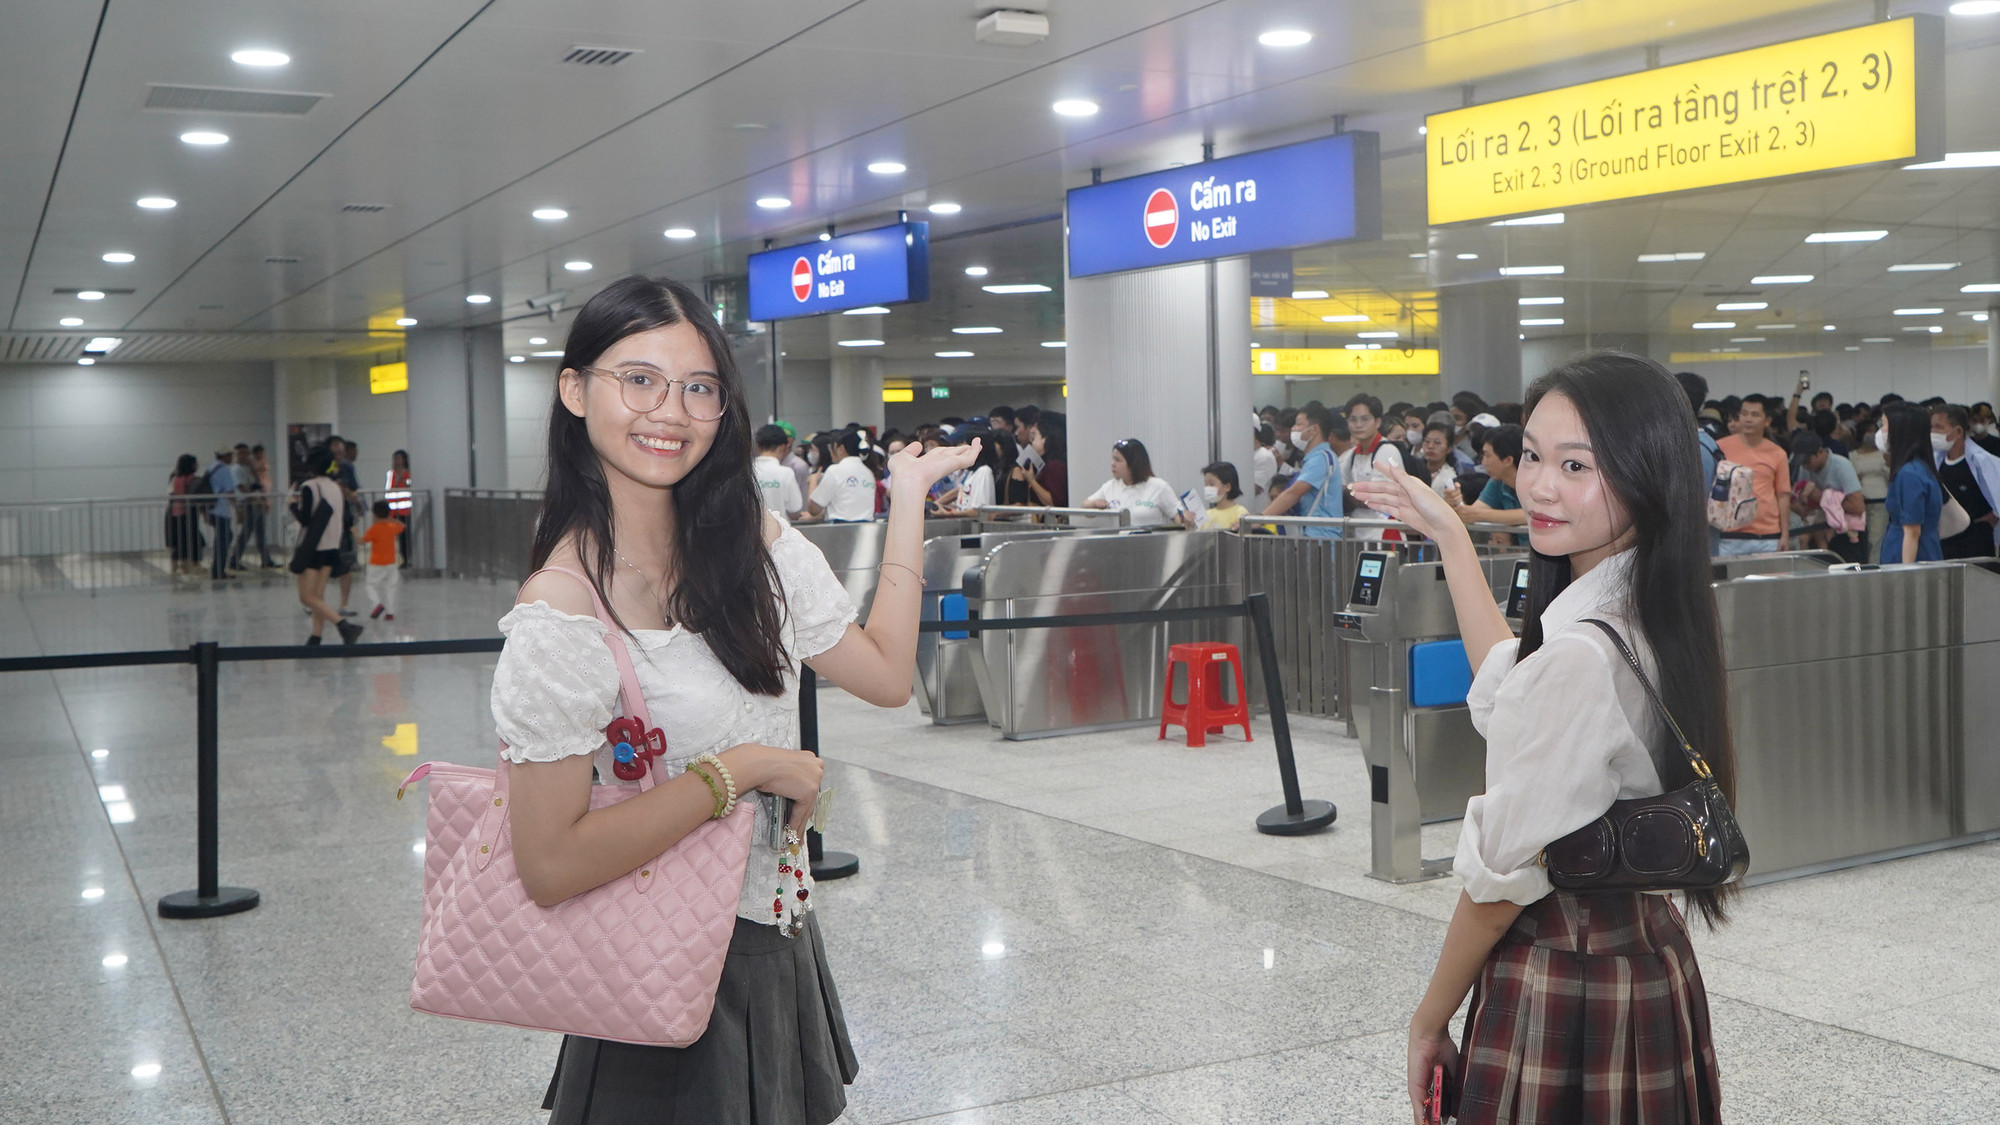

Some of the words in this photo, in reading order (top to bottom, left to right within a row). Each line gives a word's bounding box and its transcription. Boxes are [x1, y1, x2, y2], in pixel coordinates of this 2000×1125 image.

[1441, 127, 1475, 166] Lối
[1484, 133, 1508, 158] ra
[1517, 121, 1538, 152] 2,
[1548, 115, 1561, 146] 3
[1573, 98, 1622, 146] (Lối
[1634, 104, 1662, 131] ra
[1673, 83, 1738, 125] tầng
[1751, 69, 1808, 115] trệt
[1821, 61, 1848, 99] 2,
[1862, 50, 1892, 94] 3)
[1493, 169, 1524, 194] Exit
[1552, 163, 1562, 184] 3
[1569, 148, 1648, 184] (Ground
[1657, 143, 1710, 169] Floor
[1720, 130, 1759, 159] Exit
[1795, 120, 1815, 148] 3)
[1190, 176, 1231, 211] Cấm
[1235, 179, 1256, 203] ra
[1191, 221, 1210, 242] No
[1212, 216, 1237, 239] Exit
[817, 249, 841, 275] Cấm
[842, 253, 855, 271] ra
[818, 282, 829, 298] No
[830, 279, 845, 297] Exit
